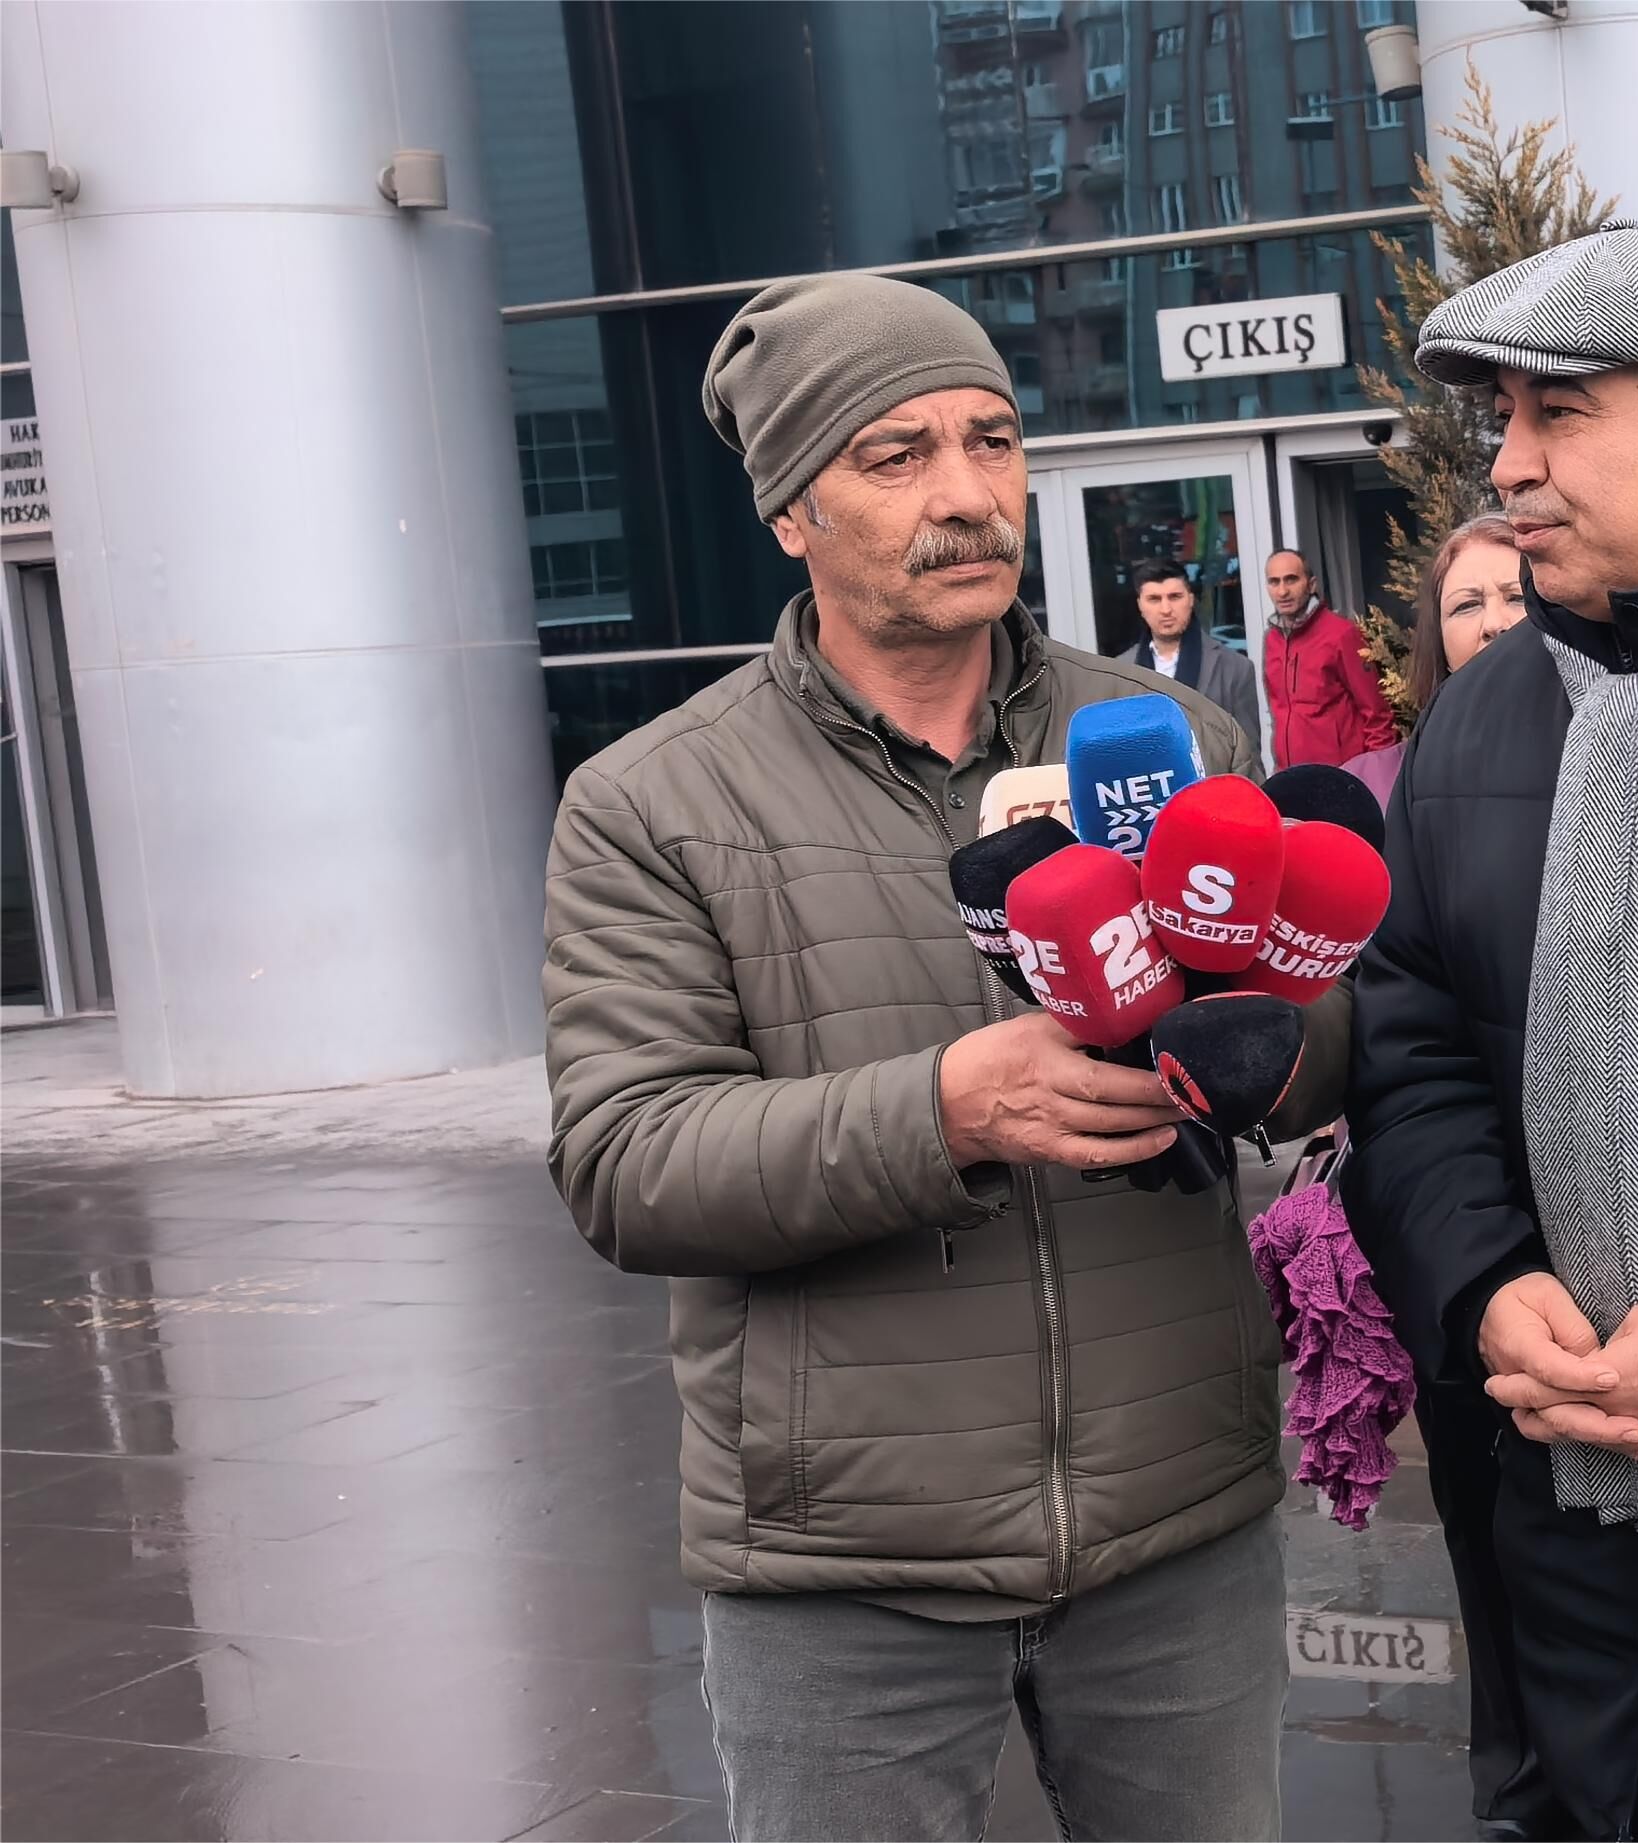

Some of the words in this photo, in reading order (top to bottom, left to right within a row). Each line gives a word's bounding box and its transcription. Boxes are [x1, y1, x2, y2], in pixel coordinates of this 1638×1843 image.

[1183, 314, 1315, 373] ÇIKIŞ
[1095, 769, 1174, 808] NET
[1181, 864, 1235, 915] S
[1113, 953, 1179, 1011] HABER
